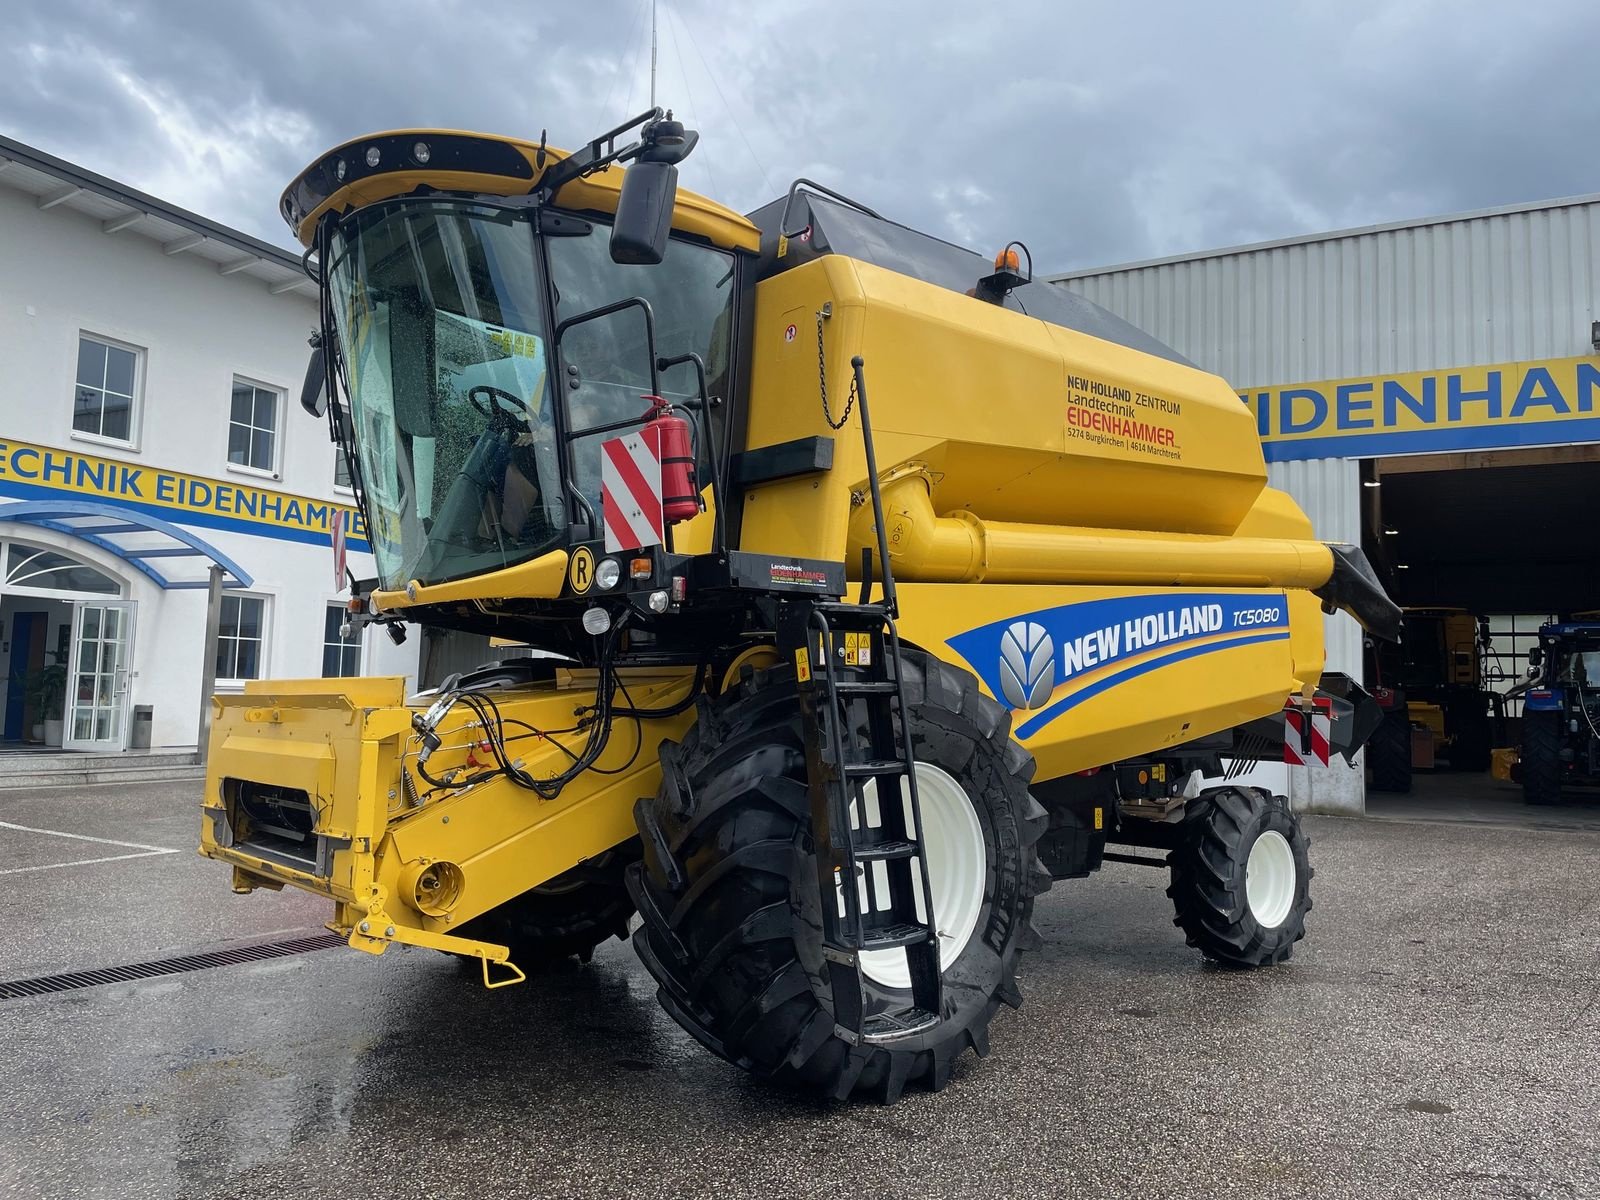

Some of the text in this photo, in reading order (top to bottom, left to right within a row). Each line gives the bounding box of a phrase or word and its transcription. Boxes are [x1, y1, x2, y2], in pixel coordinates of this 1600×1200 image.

[1067, 375, 1180, 416] NEW HOLLAND ZENTRUM
[1067, 390, 1135, 418] Landtechnik
[1067, 406, 1174, 448] EIDENHAMMER
[1067, 427, 1084, 440] 5274
[1086, 431, 1124, 448] Burgkirchen
[1130, 441, 1146, 453] 4614
[1147, 445, 1182, 461] Marchtrenk
[576, 557, 588, 584] R
[1233, 607, 1280, 627] TC5080
[1064, 604, 1223, 676] NEW HOLLAND
